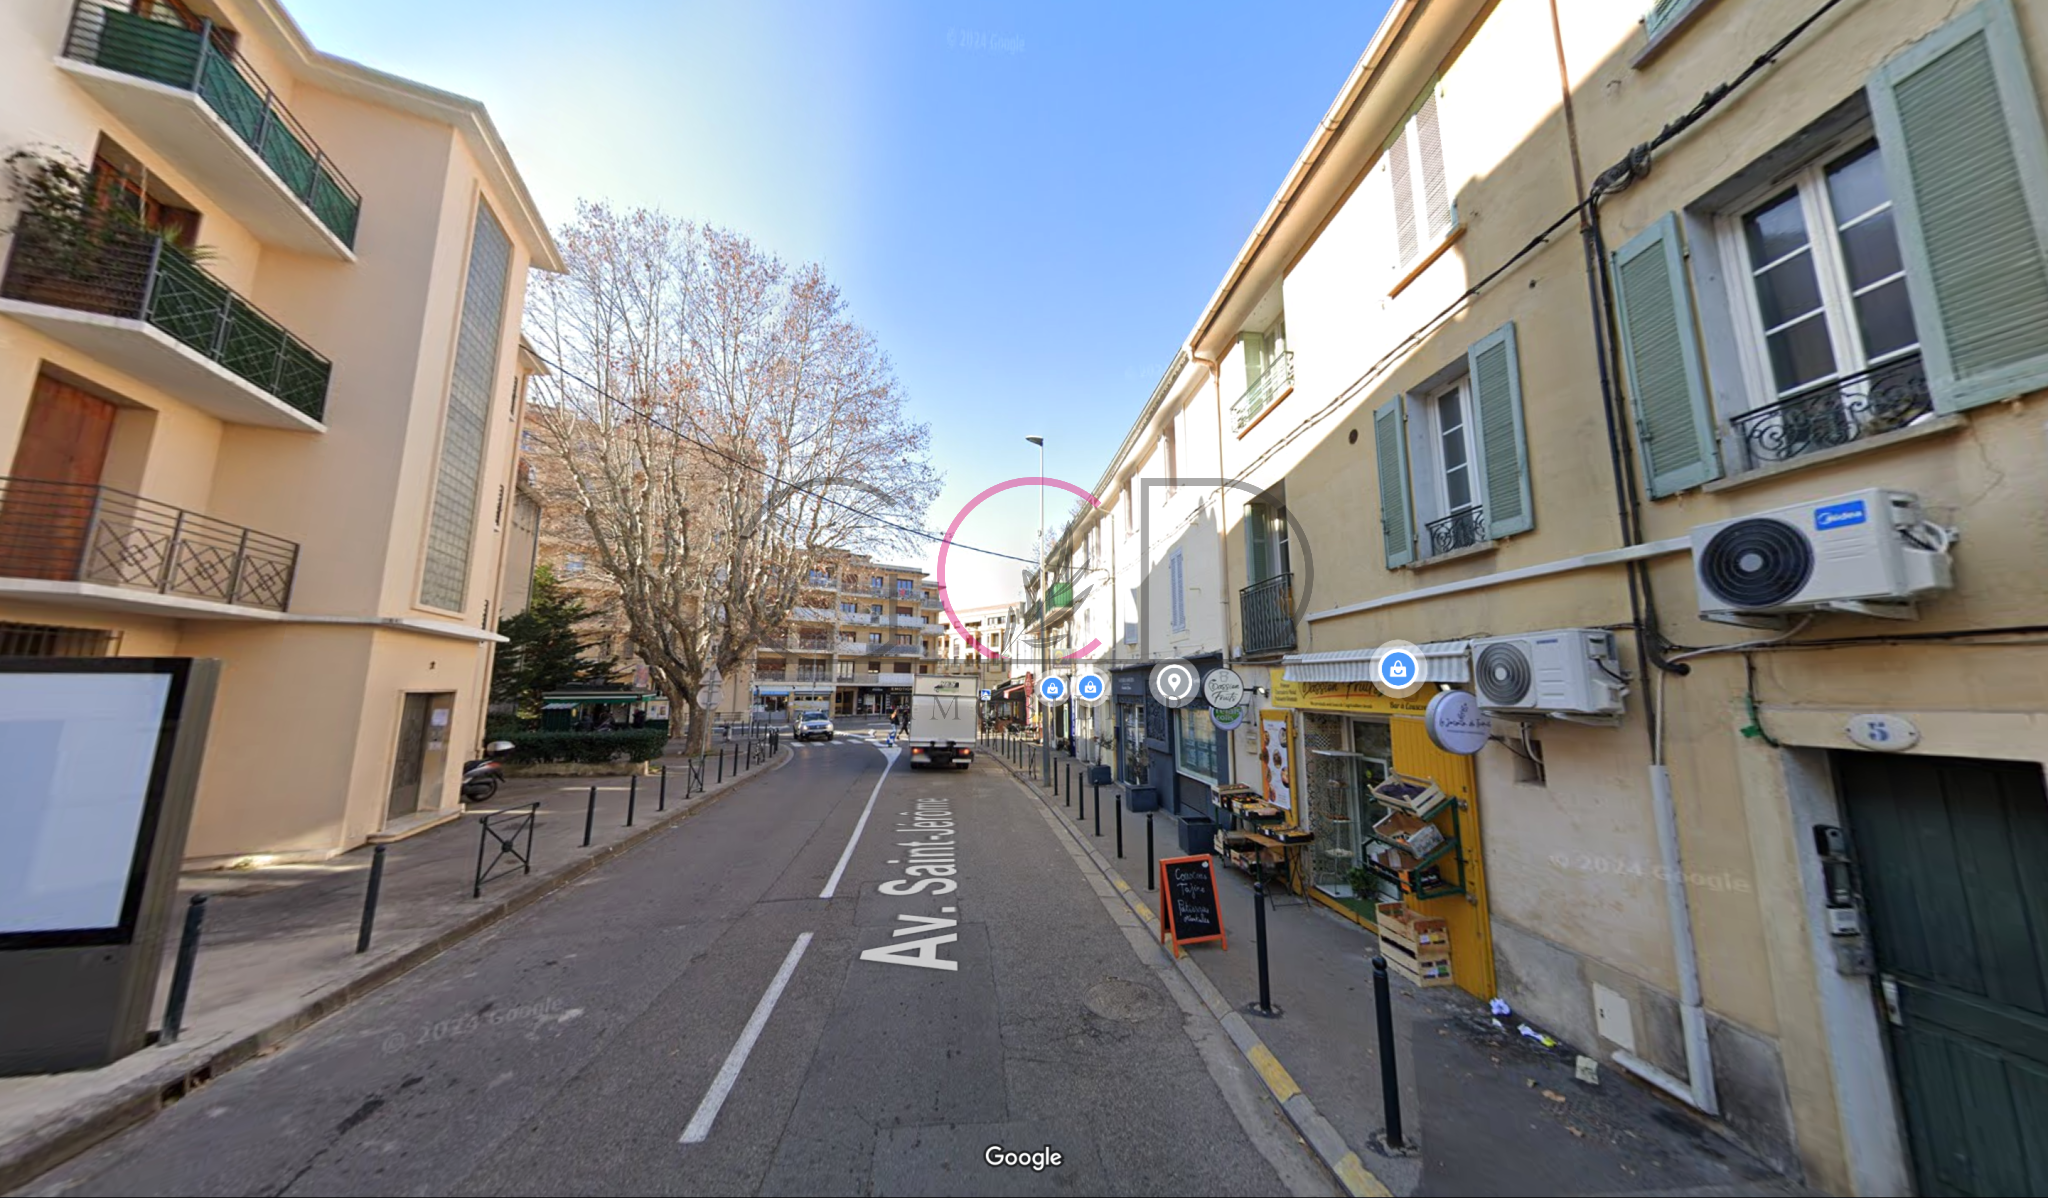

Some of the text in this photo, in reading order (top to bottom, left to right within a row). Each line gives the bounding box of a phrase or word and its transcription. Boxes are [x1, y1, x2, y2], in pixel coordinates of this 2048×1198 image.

[1208, 682, 1240, 691] Passion
[1211, 691, 1239, 703] Fruits
[1867, 722, 1890, 742] 5
